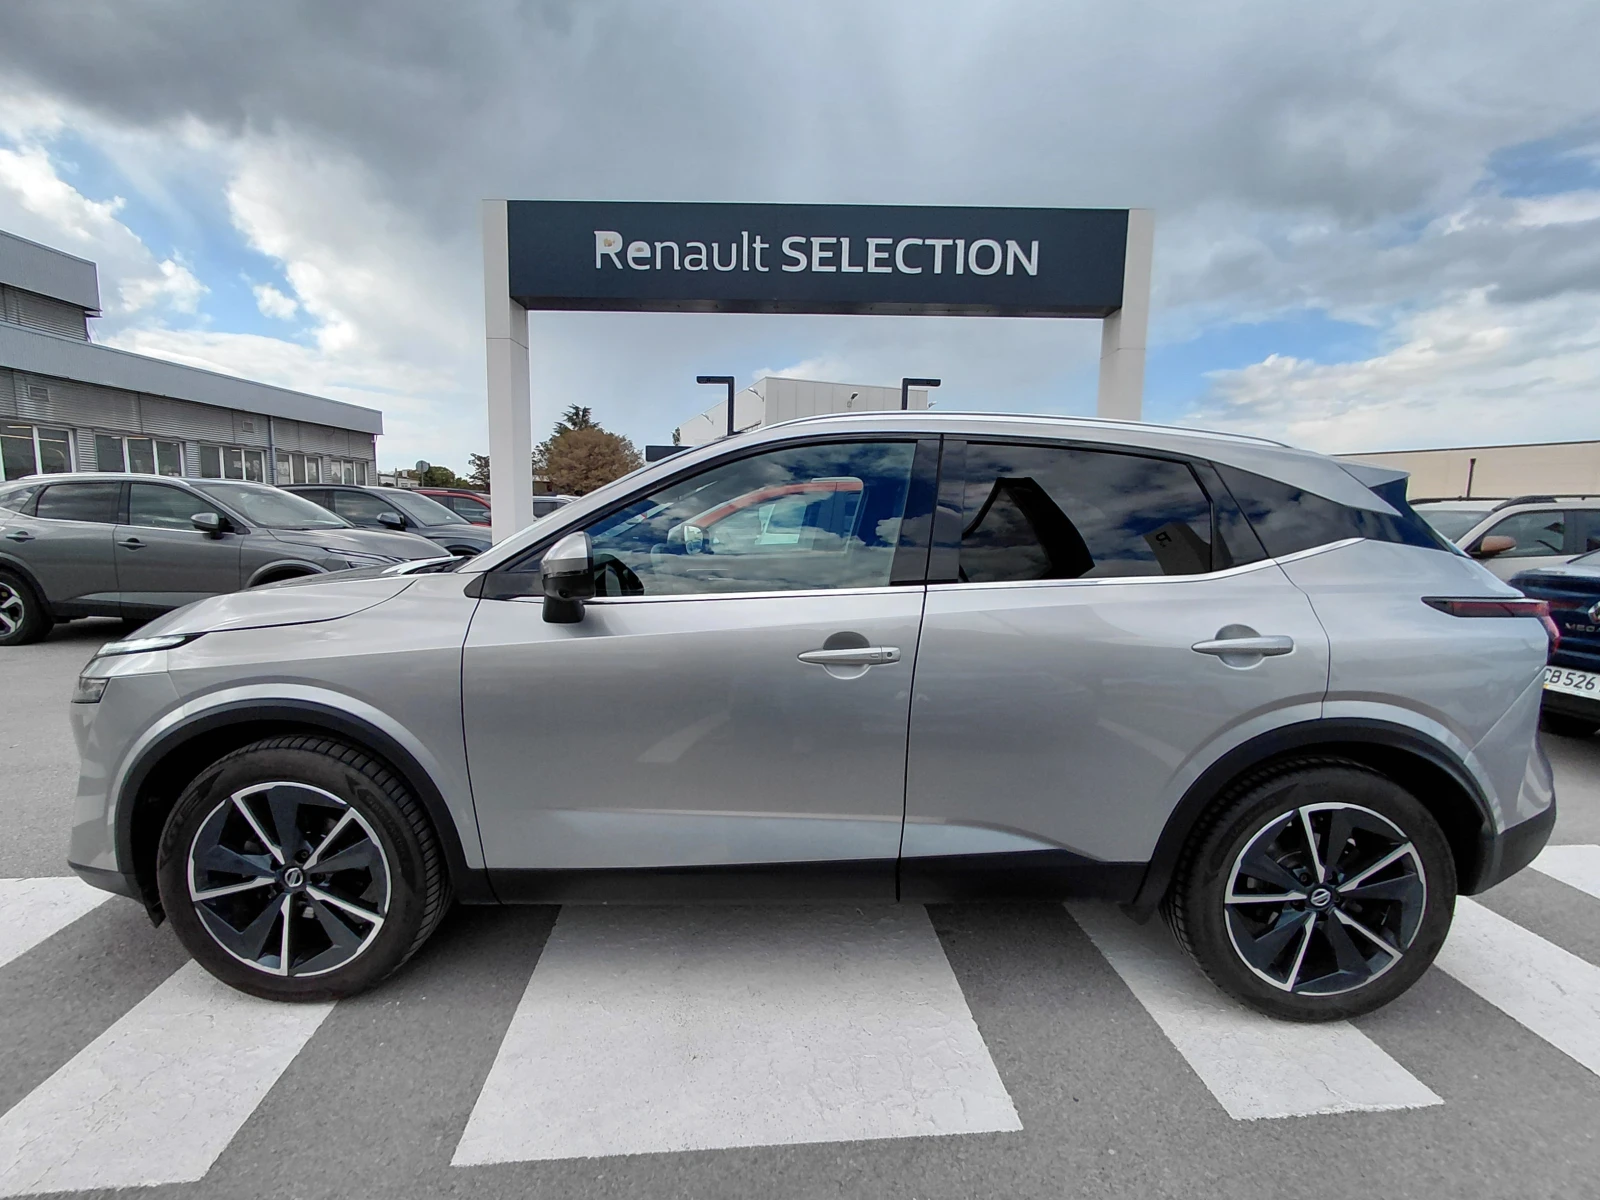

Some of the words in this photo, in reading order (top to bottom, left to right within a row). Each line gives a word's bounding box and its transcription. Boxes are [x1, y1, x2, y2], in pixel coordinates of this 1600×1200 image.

[594, 230, 769, 272] Renault
[781, 236, 1039, 276] SELECTION
[1563, 671, 1596, 690] 526
